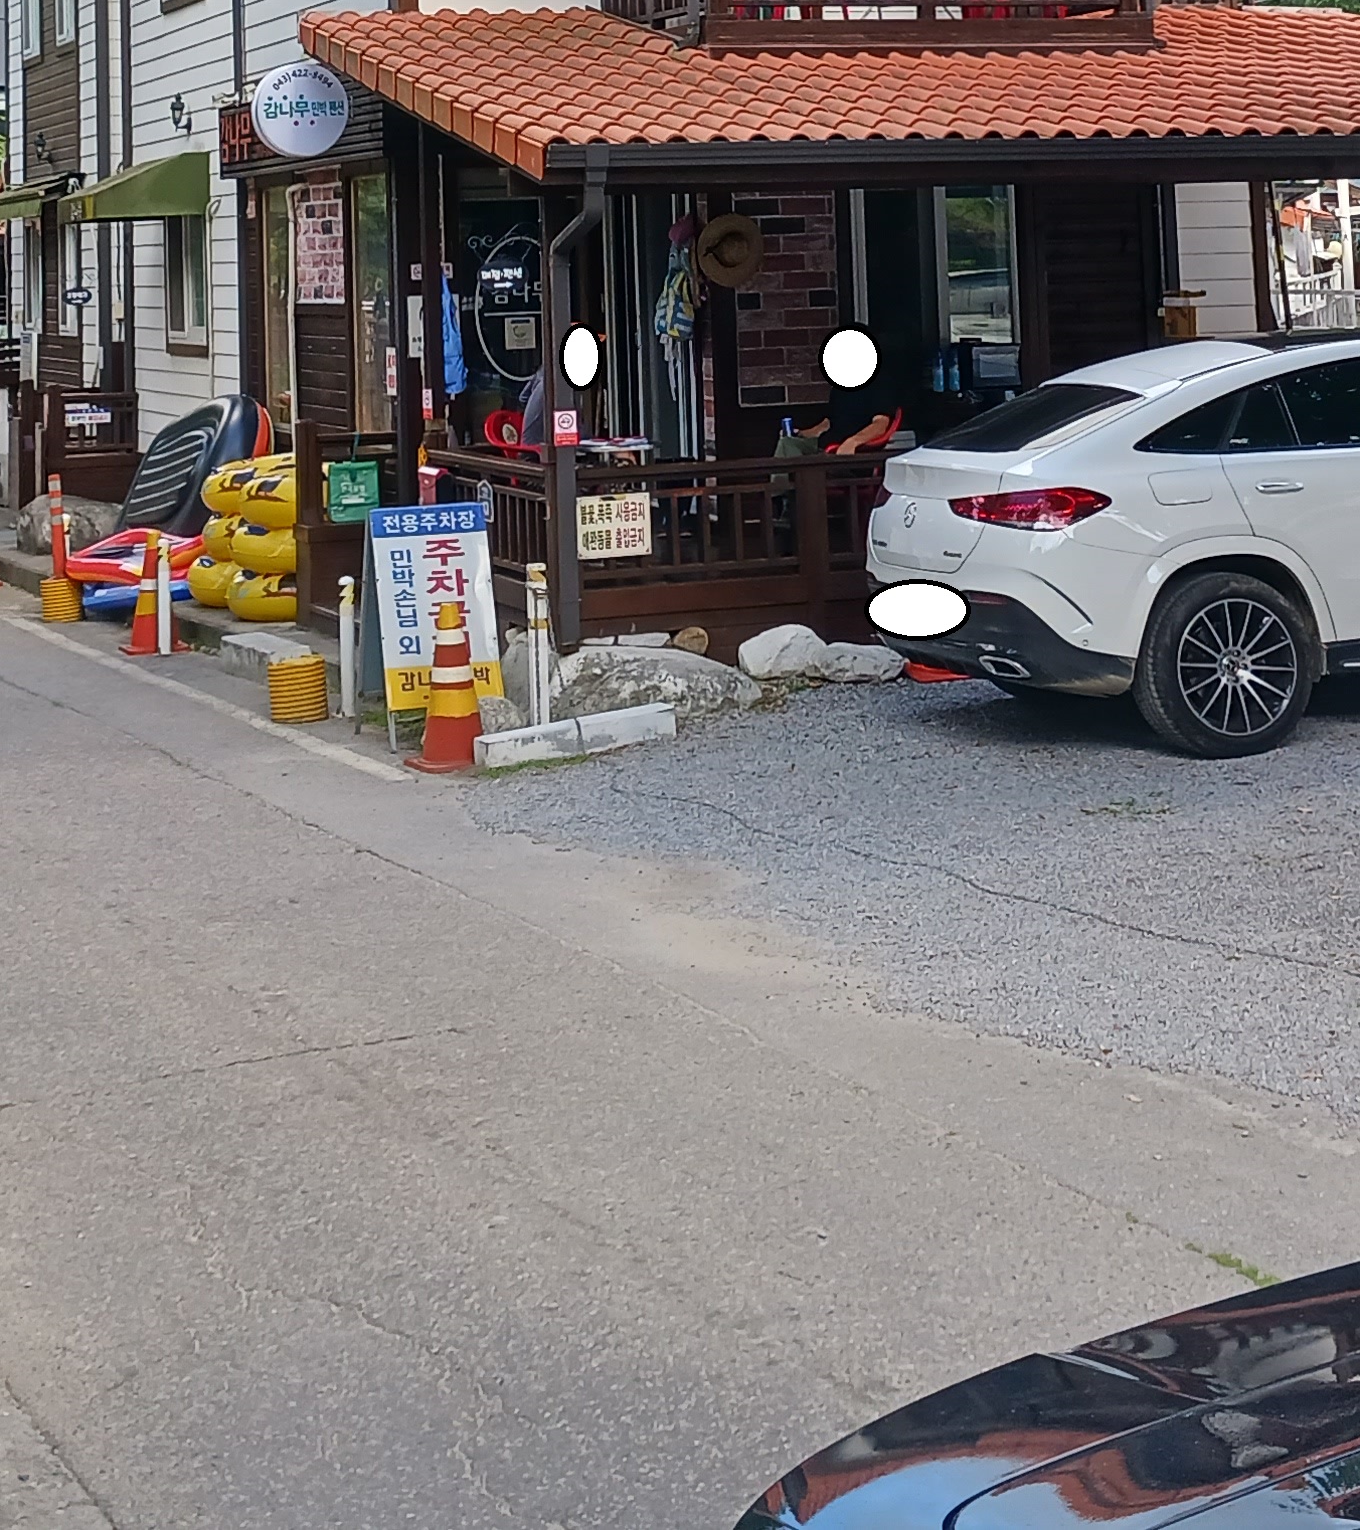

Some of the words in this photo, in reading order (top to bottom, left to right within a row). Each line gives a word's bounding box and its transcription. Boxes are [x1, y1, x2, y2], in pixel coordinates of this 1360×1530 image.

[263, 99, 310, 119] 감나무
[382, 510, 476, 533] 전용주차장
[616, 501, 645, 522] 사용금지
[616, 527, 645, 549] 출입금지
[390, 549, 418, 628] 민박손님
[399, 635, 421, 655] 외
